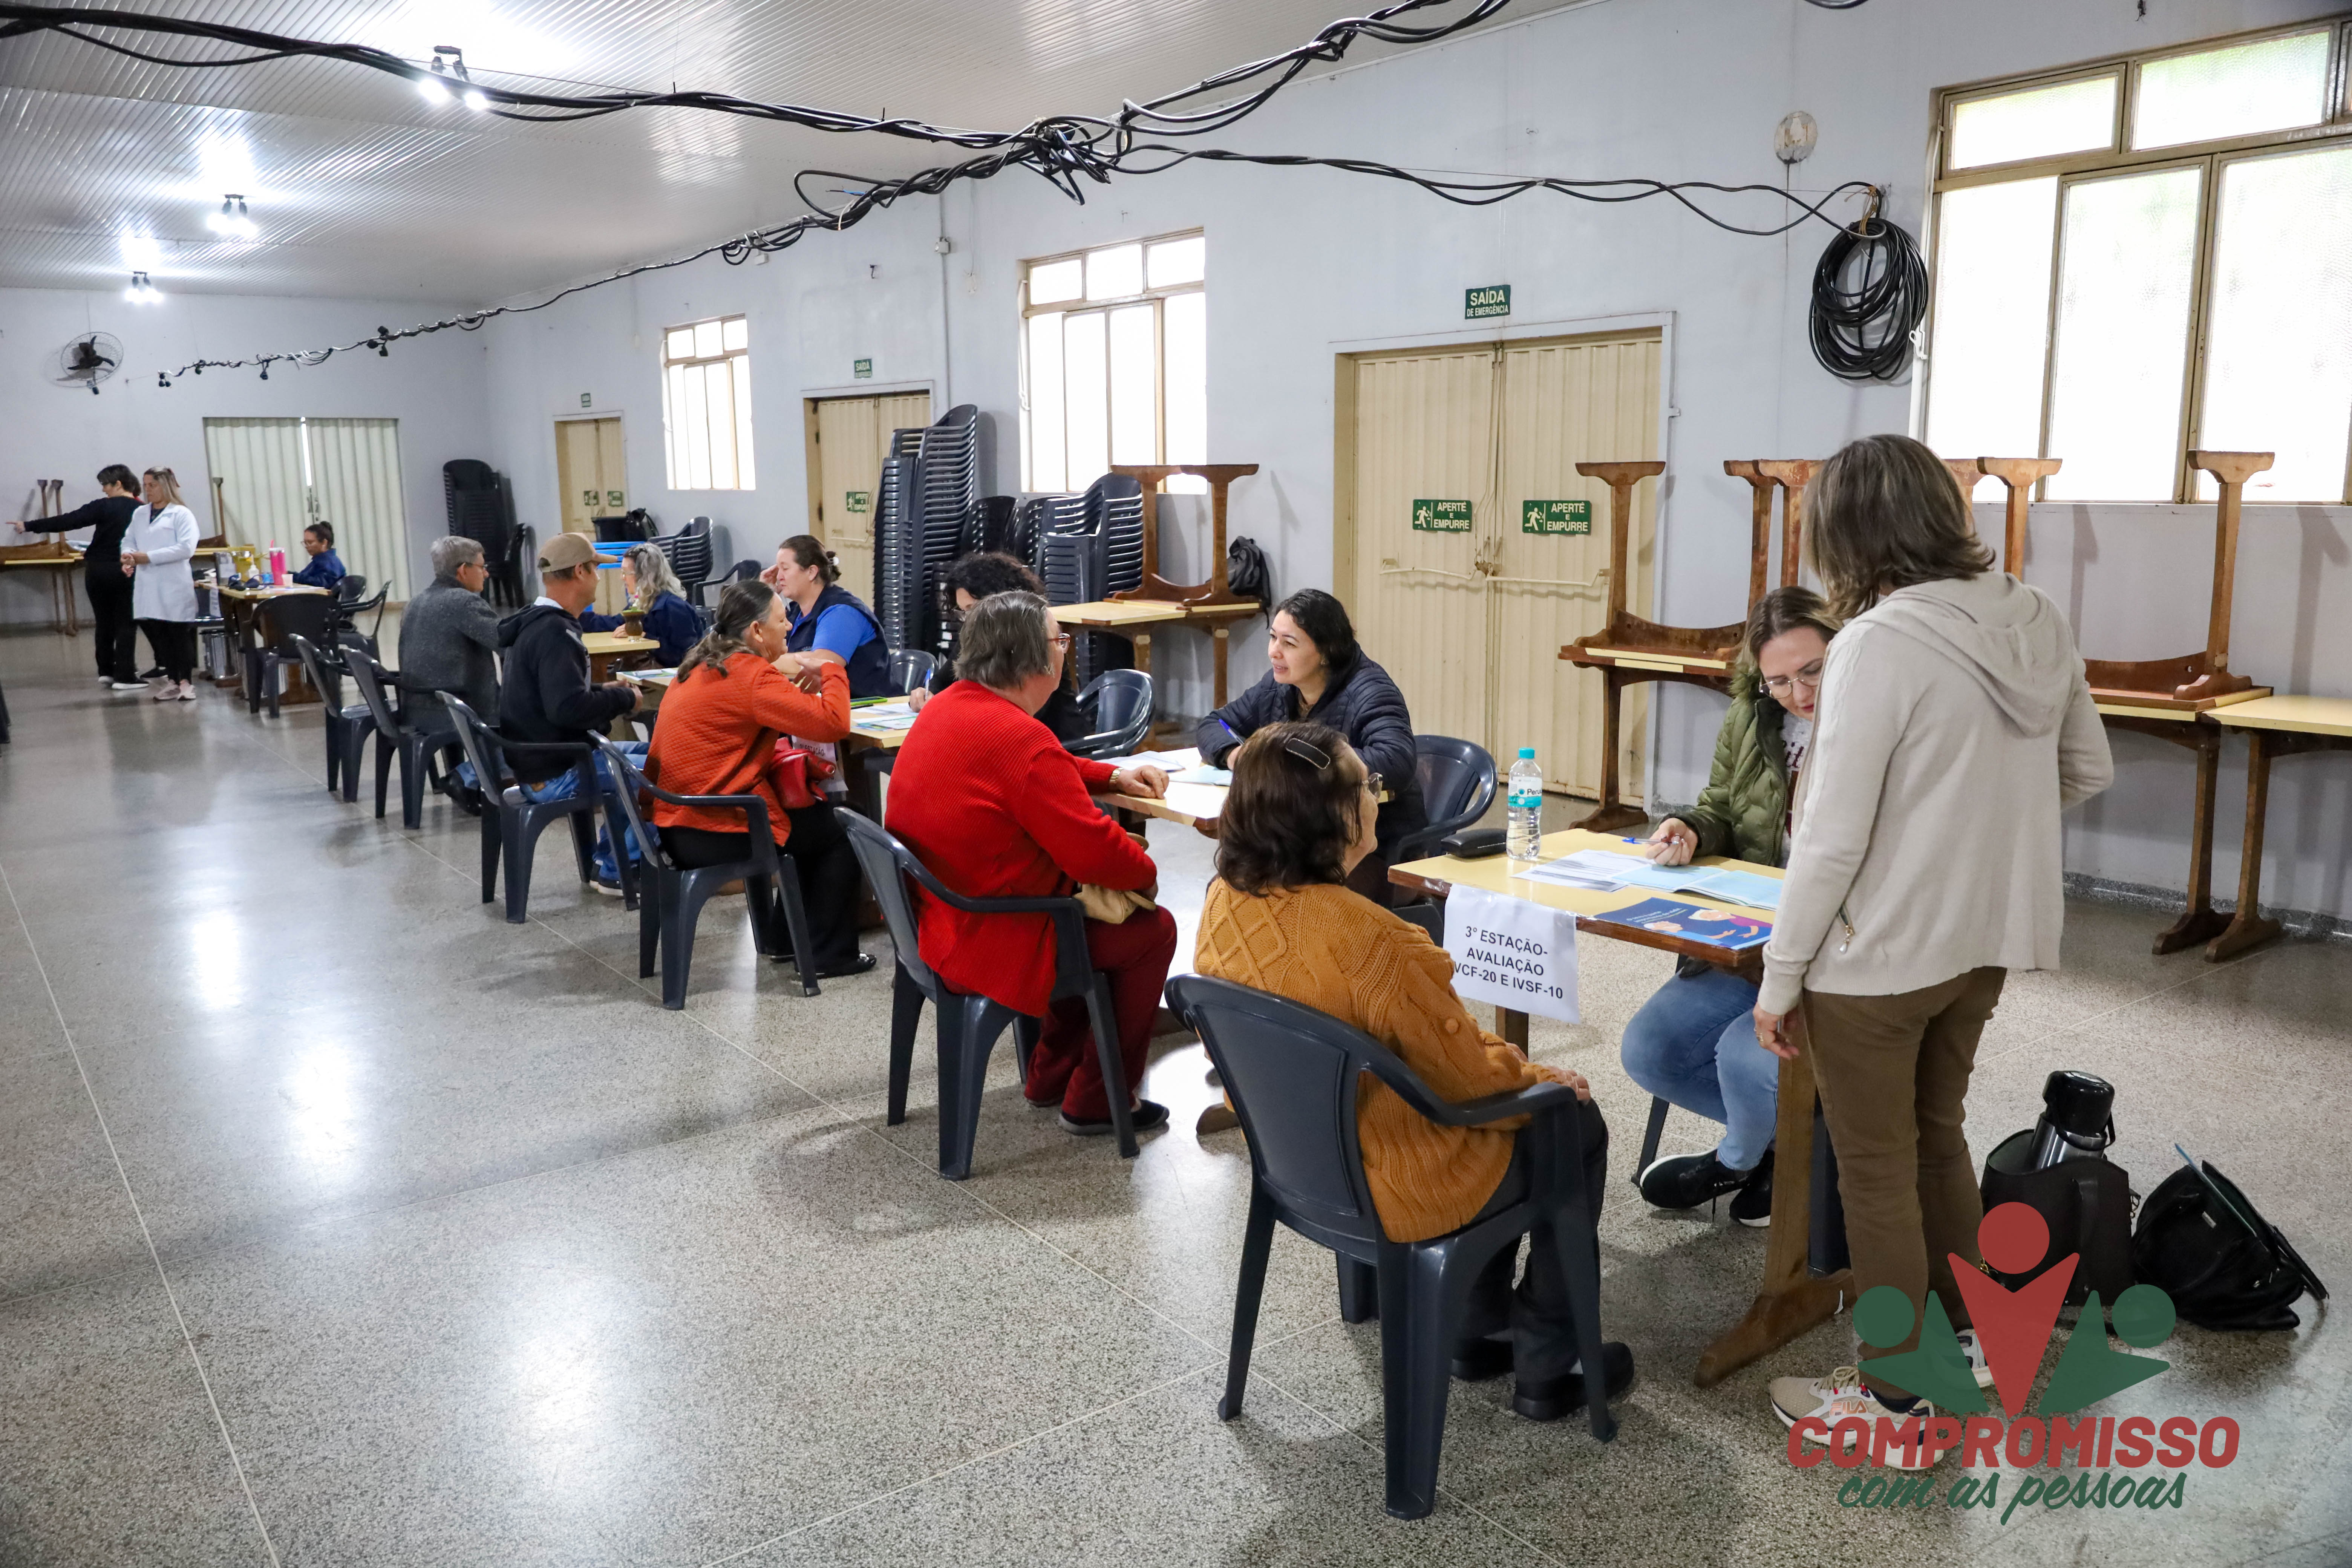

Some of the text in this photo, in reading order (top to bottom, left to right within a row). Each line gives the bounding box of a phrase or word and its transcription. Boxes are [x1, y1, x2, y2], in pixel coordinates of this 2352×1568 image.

[1470, 288, 1505, 306] SAÍDA
[1467, 304, 1508, 317] DE EMERGÊNCIA
[1437, 502, 1467, 512] APERTE
[1551, 502, 1585, 513] APERTE
[1433, 519, 1470, 530] EMPURRE
[1547, 521, 1588, 532] EMPURRE
[1480, 929, 1548, 956] ESTAÇÃO-
[1467, 947, 1544, 976] AVALIAÇÃO
[1501, 975, 1509, 986] E
[1513, 977, 1563, 999] IVSF-10
[1829, 1399, 1868, 1416] FILA
